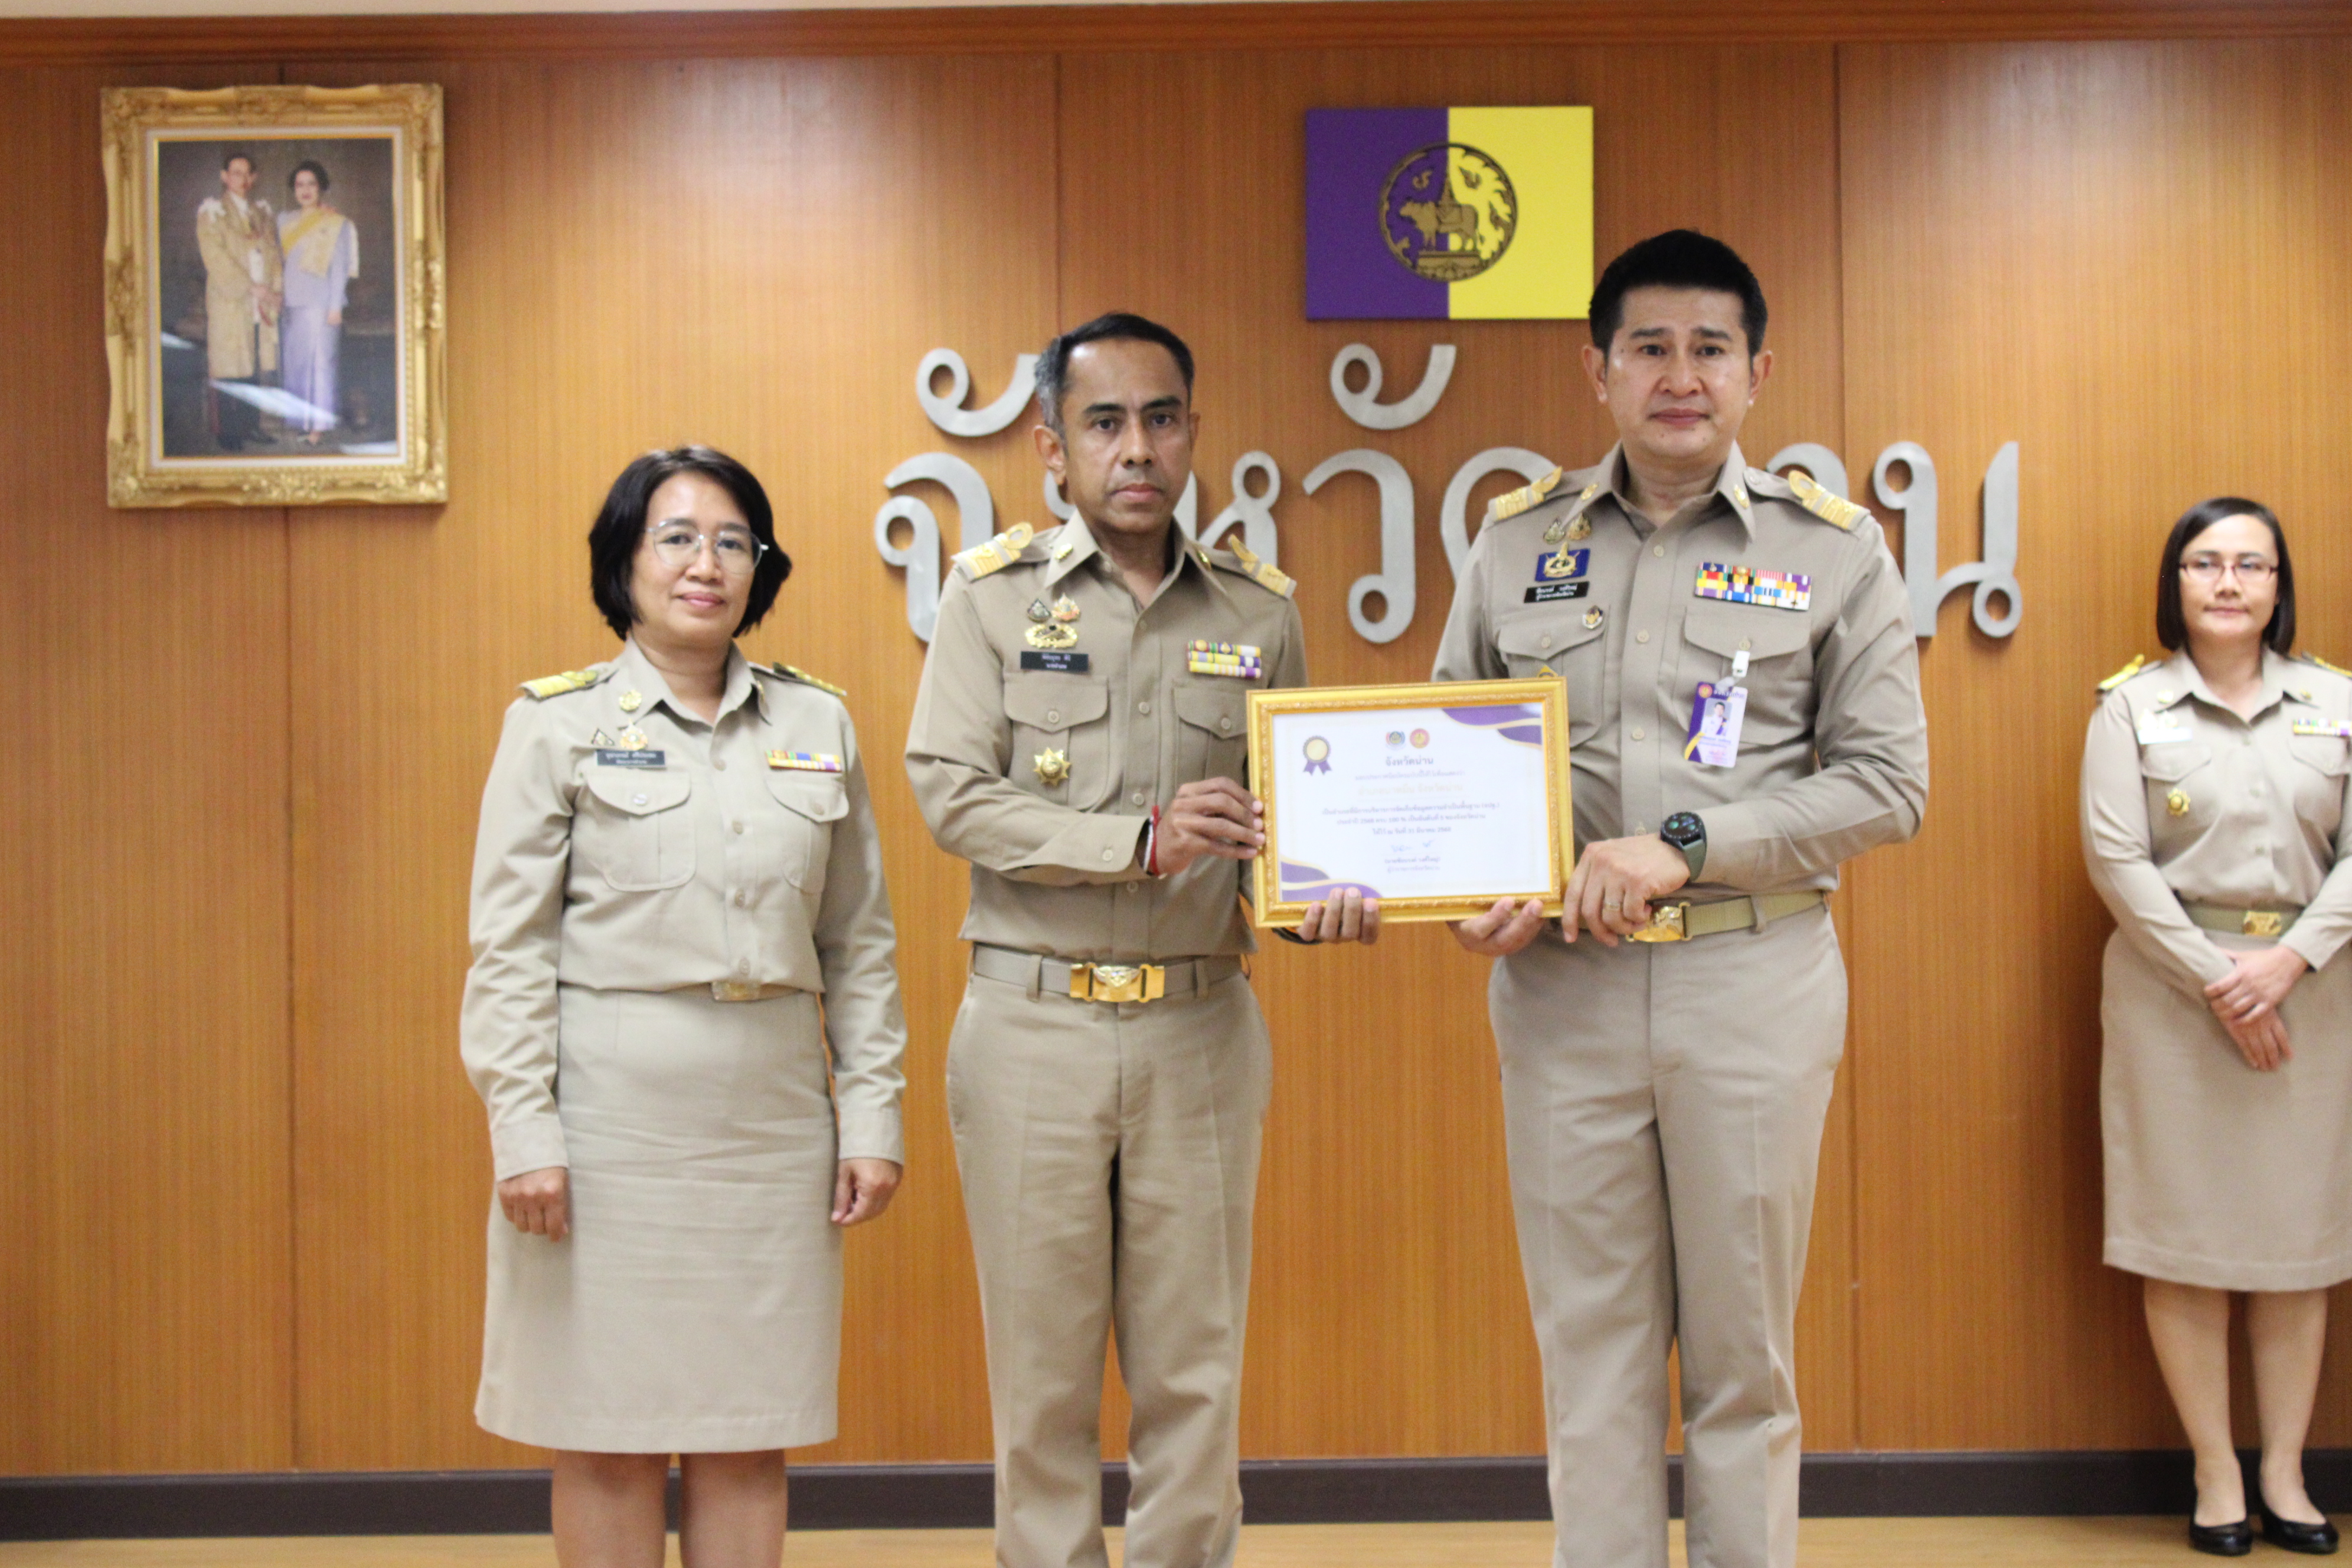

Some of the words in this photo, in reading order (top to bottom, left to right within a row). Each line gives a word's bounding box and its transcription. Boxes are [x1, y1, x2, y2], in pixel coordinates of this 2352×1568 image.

[1385, 755, 1434, 767] จังหวัดน่าน
